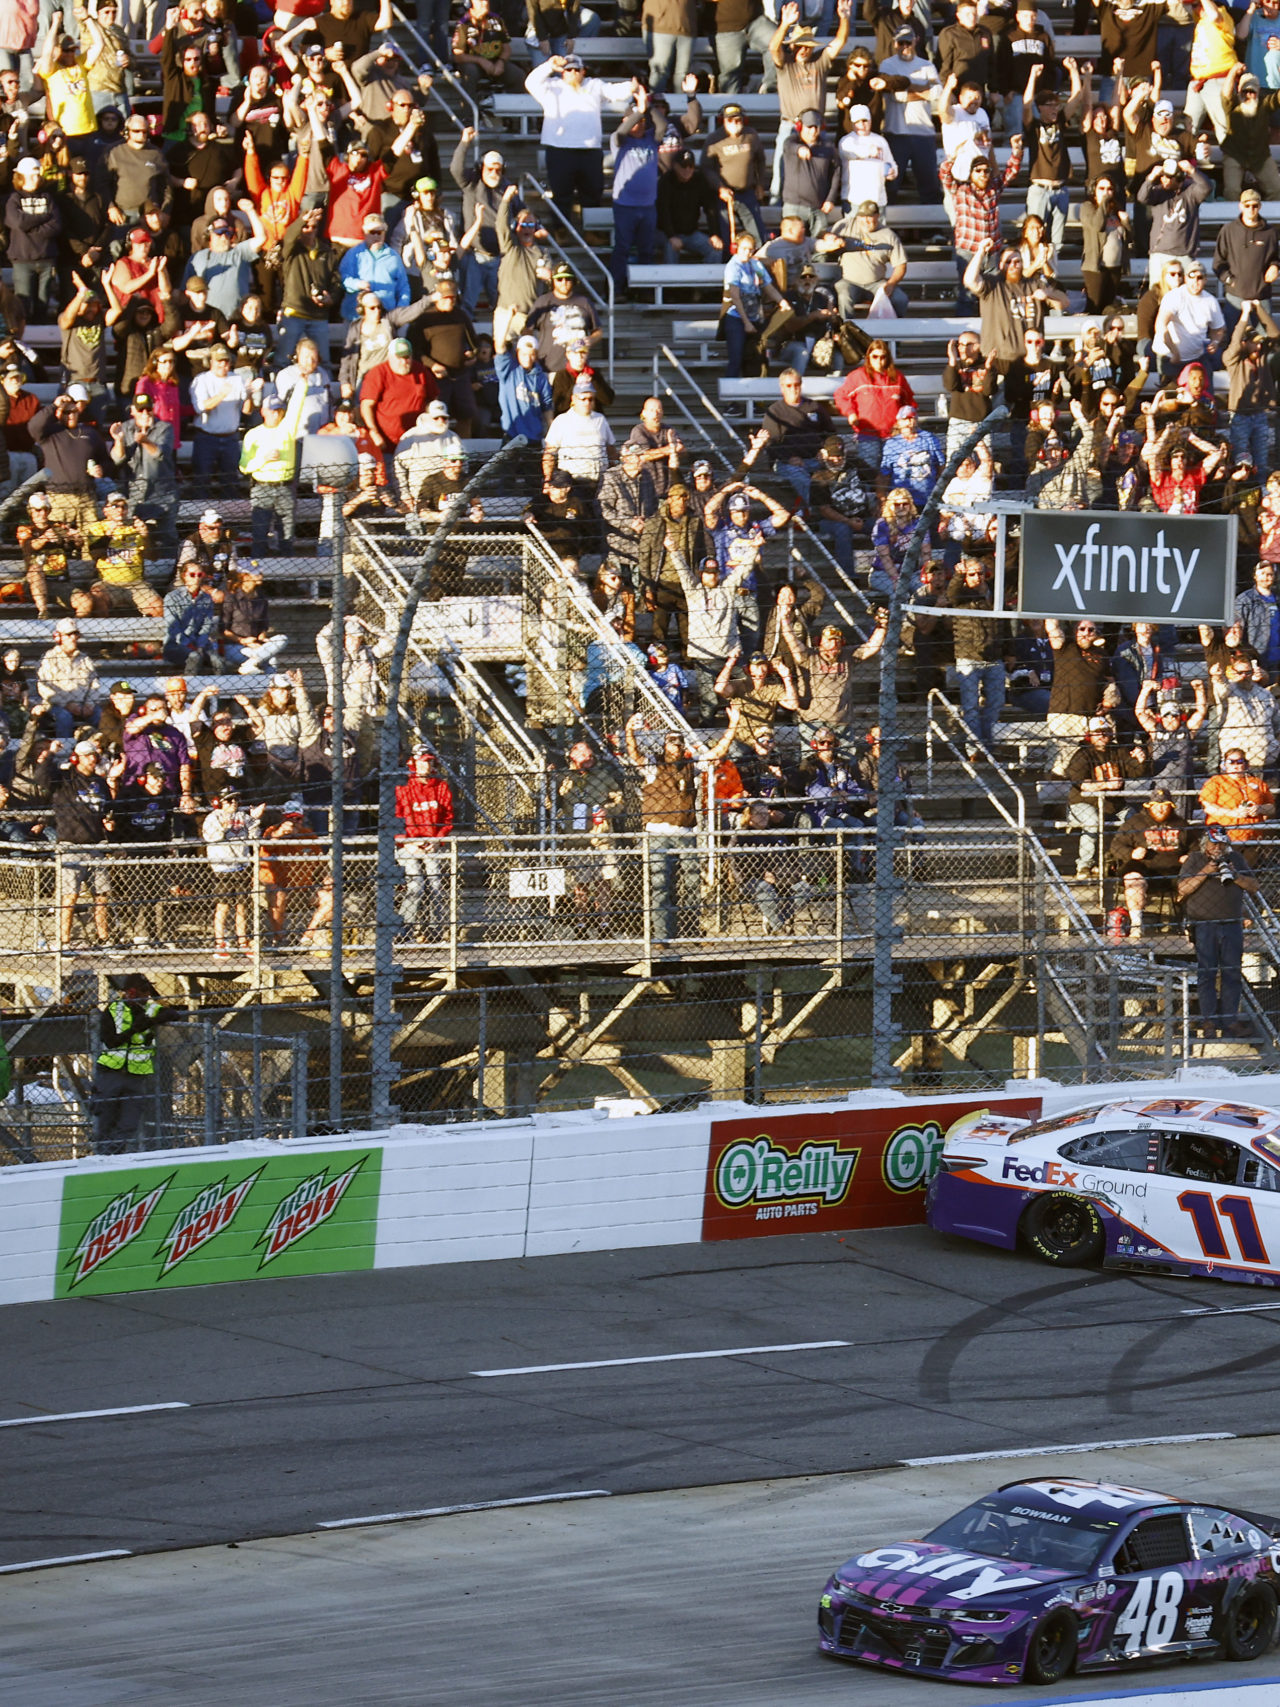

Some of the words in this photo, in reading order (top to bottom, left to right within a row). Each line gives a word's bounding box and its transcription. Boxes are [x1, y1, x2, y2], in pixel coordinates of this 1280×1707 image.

[1052, 522, 1201, 614] xfinity
[527, 873, 549, 892] 4B
[722, 1144, 852, 1199] O'Reilly
[1002, 1156, 1079, 1189] FedEx
[1082, 1173, 1148, 1198] Ground
[755, 1205, 783, 1221] AUTO
[784, 1202, 818, 1218] PARTS
[1176, 1189, 1271, 1265] 11
[1010, 1506, 1072, 1524] BOWMAN
[856, 1548, 1043, 1601] ally
[1114, 1571, 1184, 1653] 48
